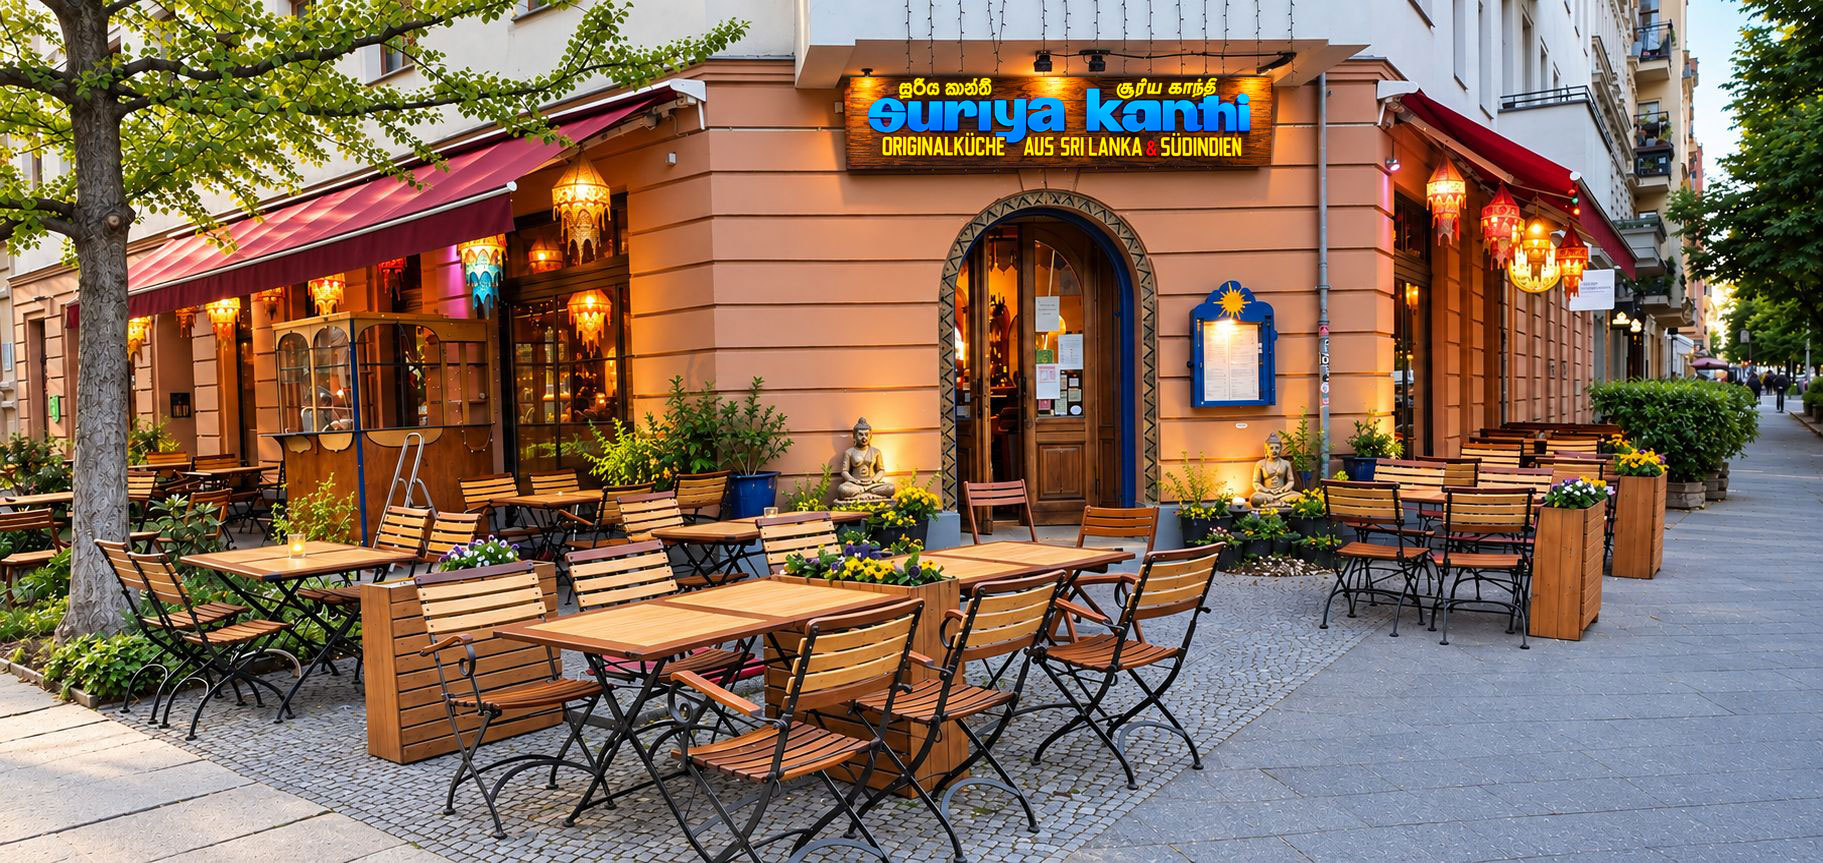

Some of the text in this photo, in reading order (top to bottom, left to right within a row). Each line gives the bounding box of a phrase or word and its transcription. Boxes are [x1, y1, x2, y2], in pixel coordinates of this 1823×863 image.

[1116, 77, 1218, 100] சூரிய காந்தி
[881, 132, 1242, 157] ORIGINALKÜCHE AUS SRI LANKA & SÜDINDIEN
